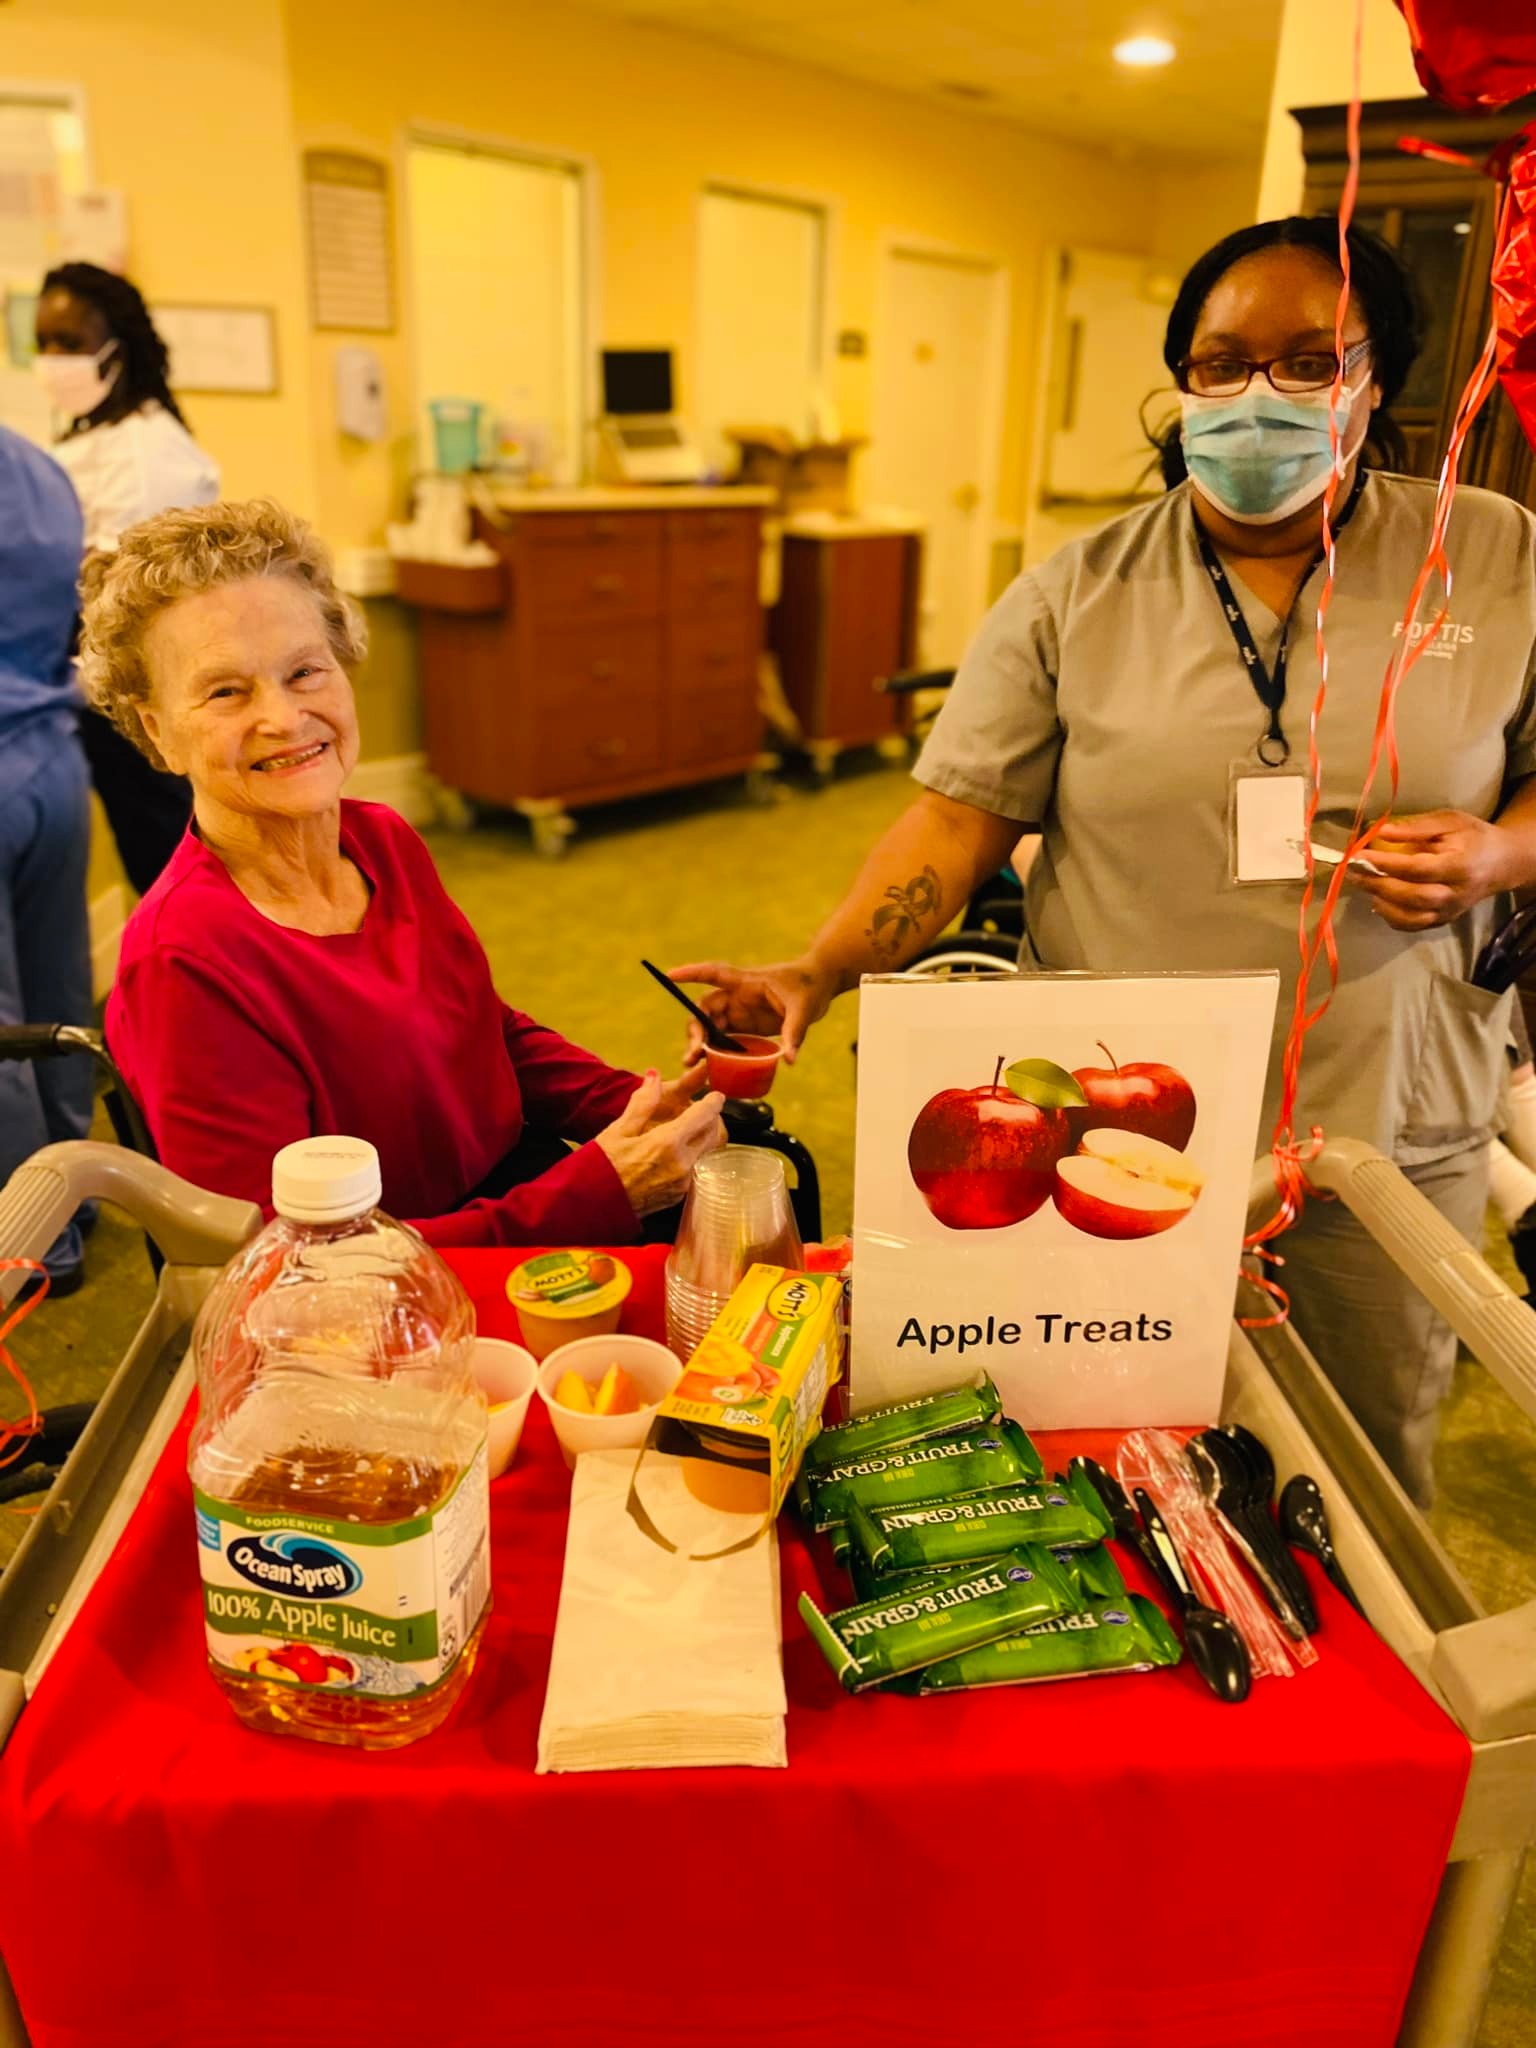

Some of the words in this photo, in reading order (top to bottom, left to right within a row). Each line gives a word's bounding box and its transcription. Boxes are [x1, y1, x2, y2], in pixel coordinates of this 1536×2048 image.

[896, 1315, 1022, 1354] Apple
[1035, 1313, 1173, 1344] Treats
[245, 1516, 335, 1535] FOODSERVICE
[207, 1589, 261, 1620] 100%
[266, 1599, 337, 1634] Apple
[342, 1612, 397, 1647] Juice
